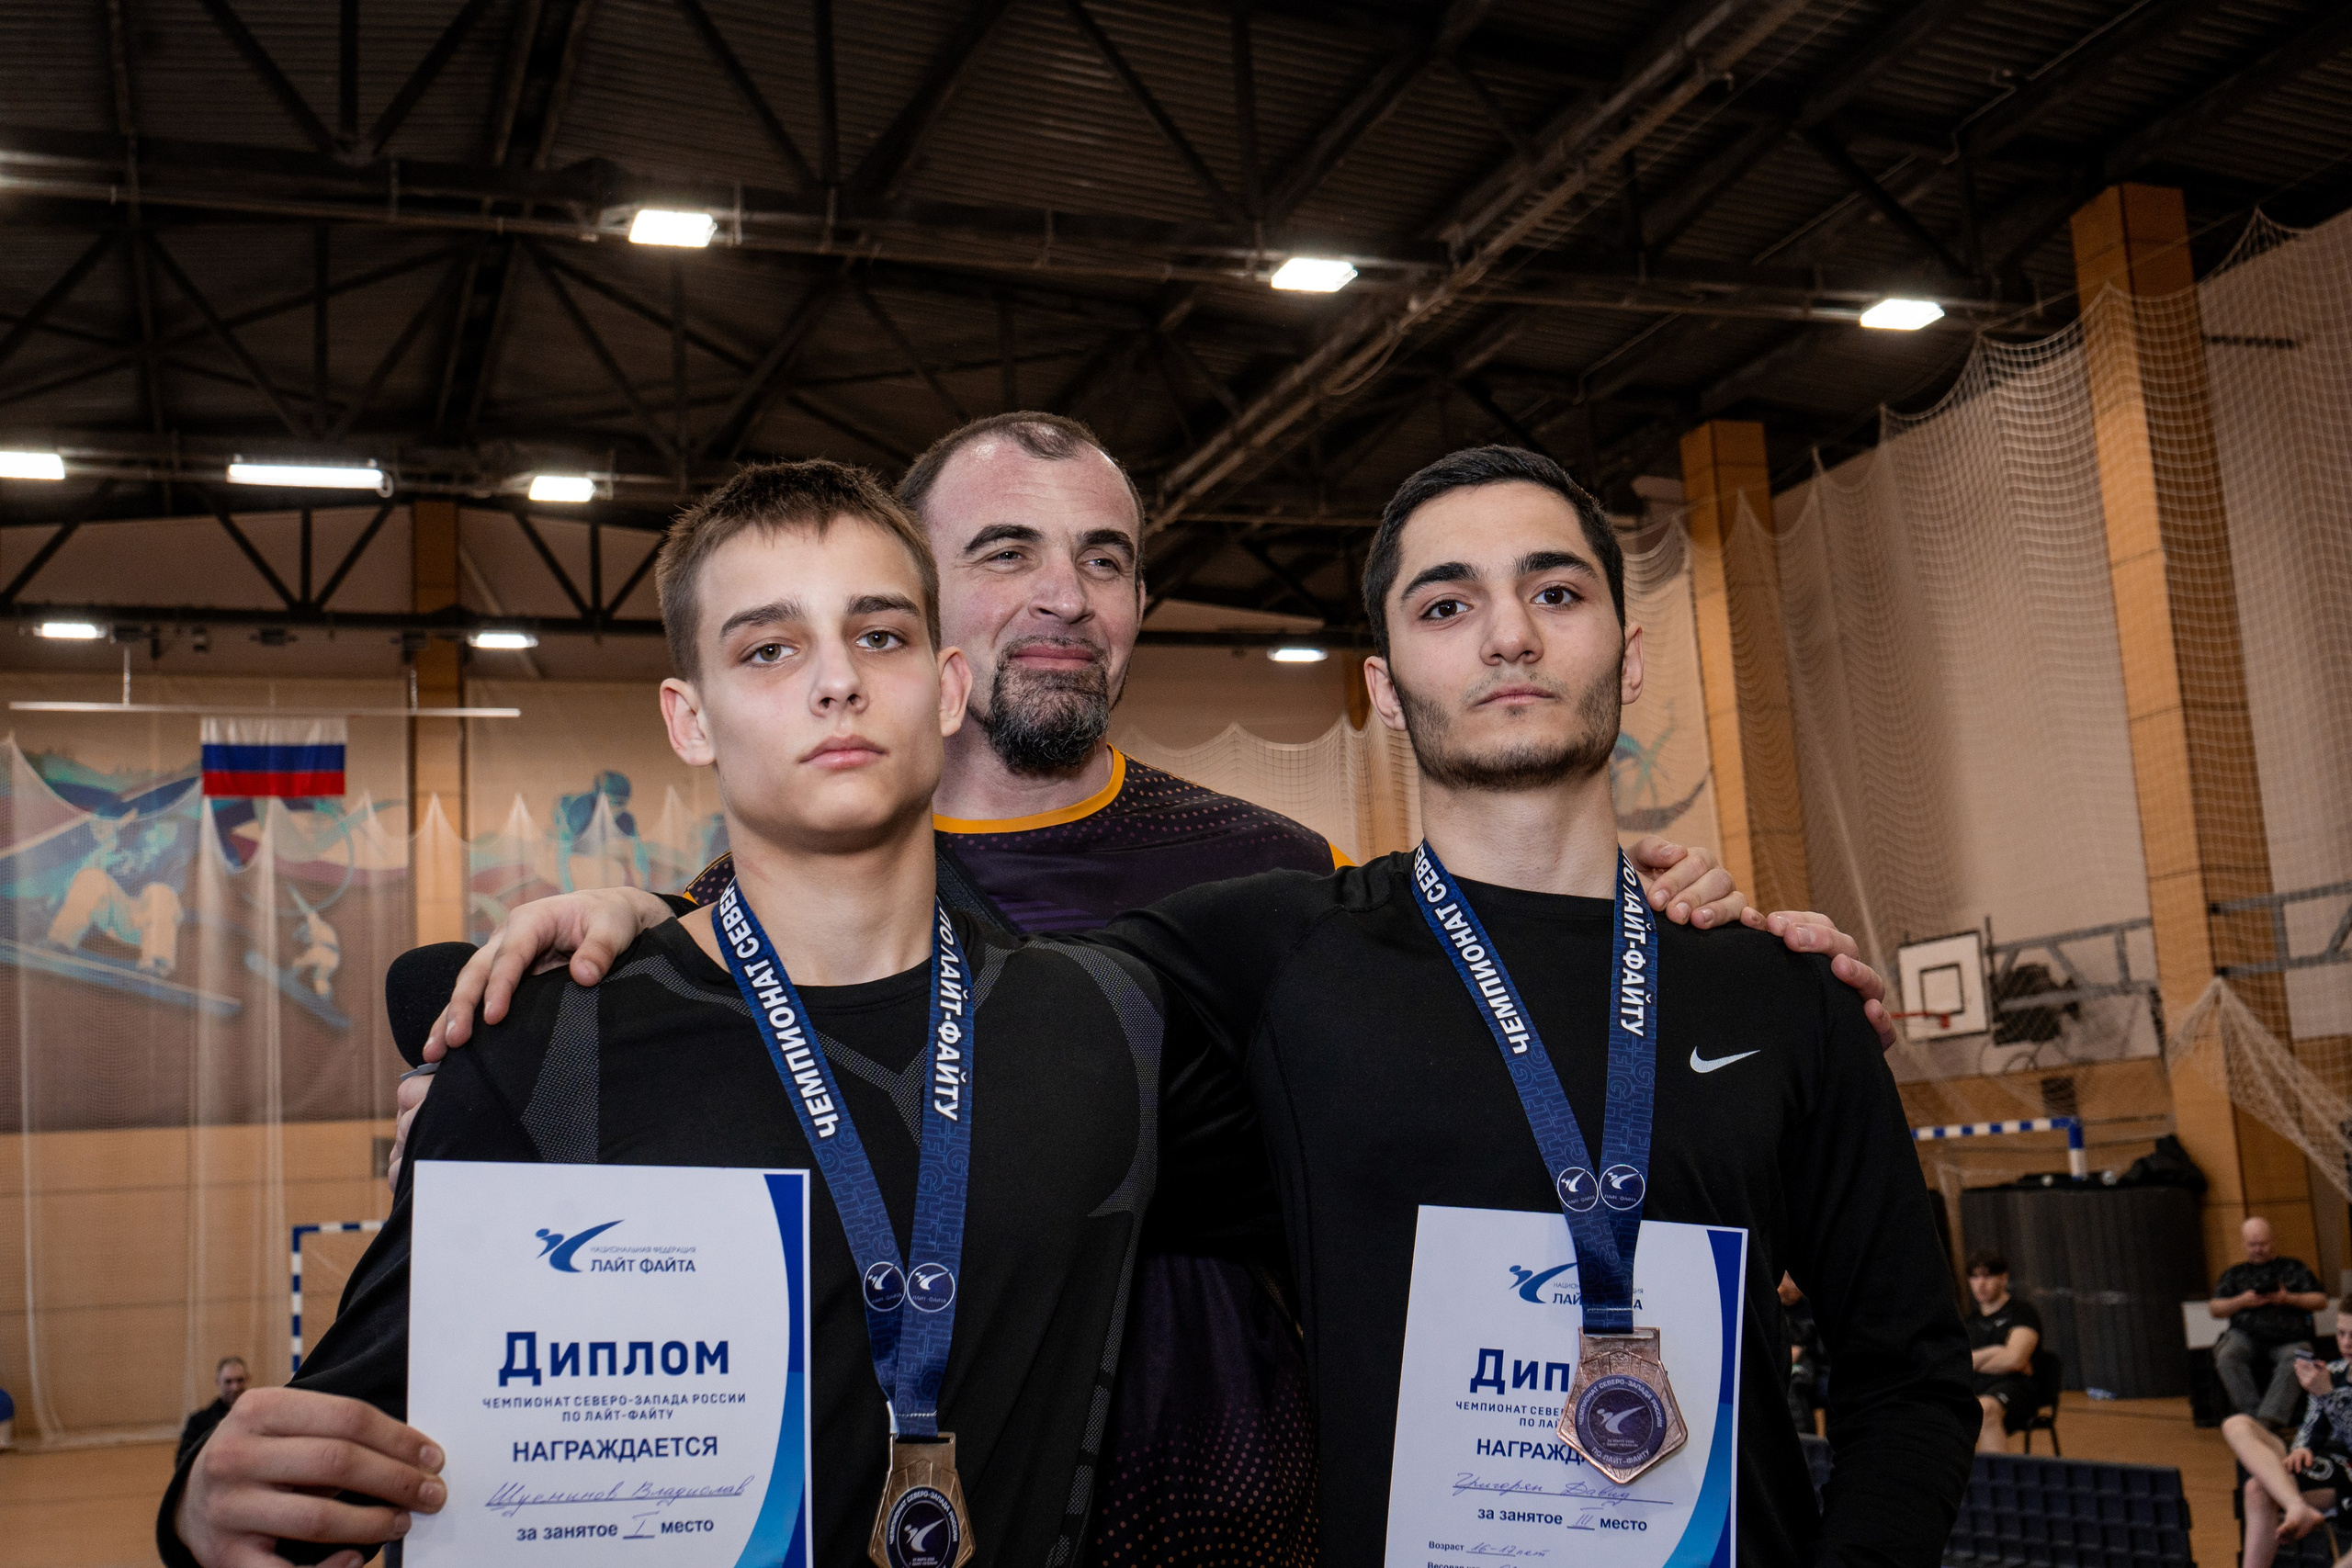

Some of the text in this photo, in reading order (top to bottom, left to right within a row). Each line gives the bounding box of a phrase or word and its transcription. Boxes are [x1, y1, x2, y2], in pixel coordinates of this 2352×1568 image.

[1415, 843, 1532, 1055] ЧЕМПИОНАТ СЕВЕ
[1621, 884, 1652, 1038] ЛАЙТ-ФАЙТУ
[934, 943, 969, 1121] ЛАЙТ-ФАЙТУ
[743, 958, 840, 1138] ЧЕМПИОНАТ
[590, 1257, 696, 1274] ЛАЙТ ФАЙТА
[1553, 1292, 1582, 1305] ЛАЙ
[498, 1331, 729, 1388] Диплом
[1470, 1348, 1570, 1395] Дип
[482, 1393, 746, 1409] ЧЕМПИОНАТ СЕВЕРО-ЗАПАДА РОССИИ
[1455, 1401, 1528, 1415] ЧЕМПИОНАТ
[562, 1407, 673, 1422] ПО ЛАЙТ-ФАЙТУ
[1520, 1417, 1535, 1427] ПО
[513, 1436, 718, 1463] НАГРАЖДАЕТСЯ
[1476, 1438, 1587, 1466] НАГРАЖД
[516, 1528, 537, 1541] за
[543, 1524, 618, 1540] занятое
[661, 1519, 714, 1534] место
[1477, 1508, 1495, 1519] за
[1499, 1510, 1563, 1525] занятое
[1600, 1517, 1647, 1531] место
[1428, 1540, 1464, 1551] Возраст
